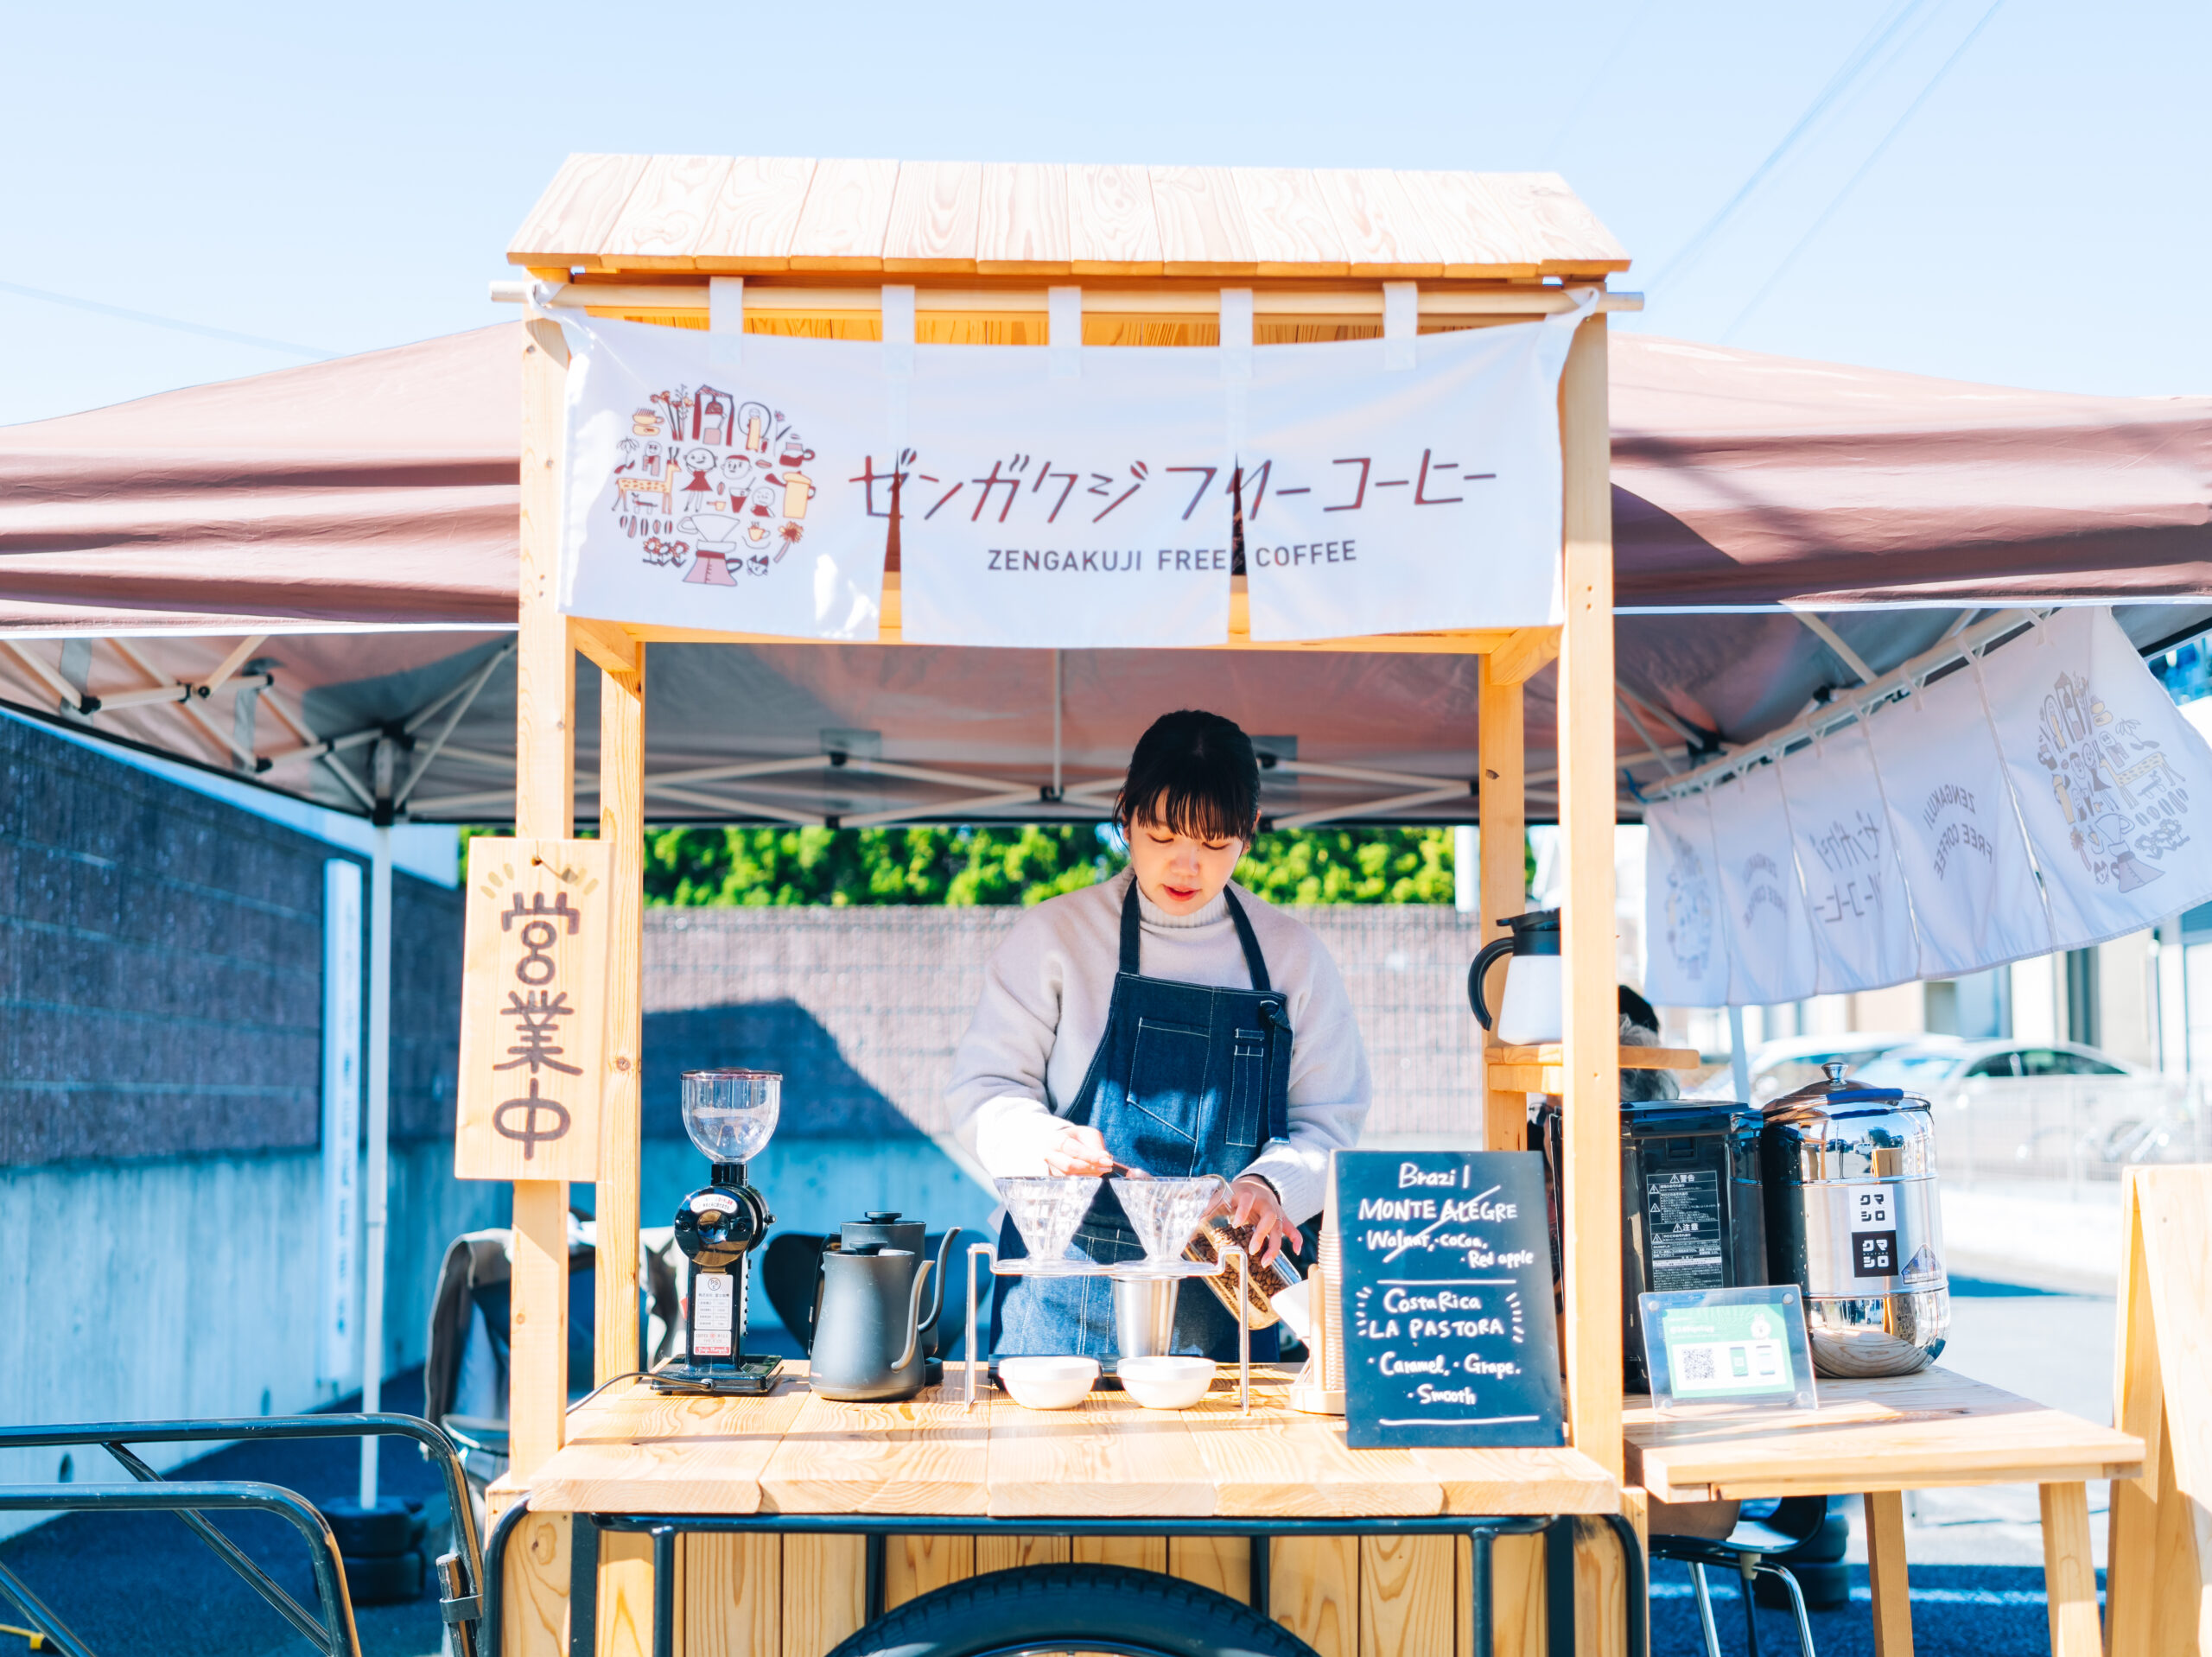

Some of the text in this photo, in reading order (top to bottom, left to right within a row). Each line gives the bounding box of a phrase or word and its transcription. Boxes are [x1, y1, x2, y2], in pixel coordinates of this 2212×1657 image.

[988, 540, 1357, 572] ZENGAKUJI FREE COFFEE
[493, 891, 583, 1161] 営業中
[1398, 1162, 1470, 1189] Brazil
[1357, 1197, 1518, 1222] MONTE ALEGRE
[1860, 1194, 1885, 1205] クマ
[1682, 1222, 1699, 1231] 注意
[1862, 1239, 1888, 1252] クマ
[1468, 1249, 1535, 1269] Red apple
[1369, 1317, 1504, 1339] LA PASTORA
[1417, 1384, 1477, 1406] Smooth
